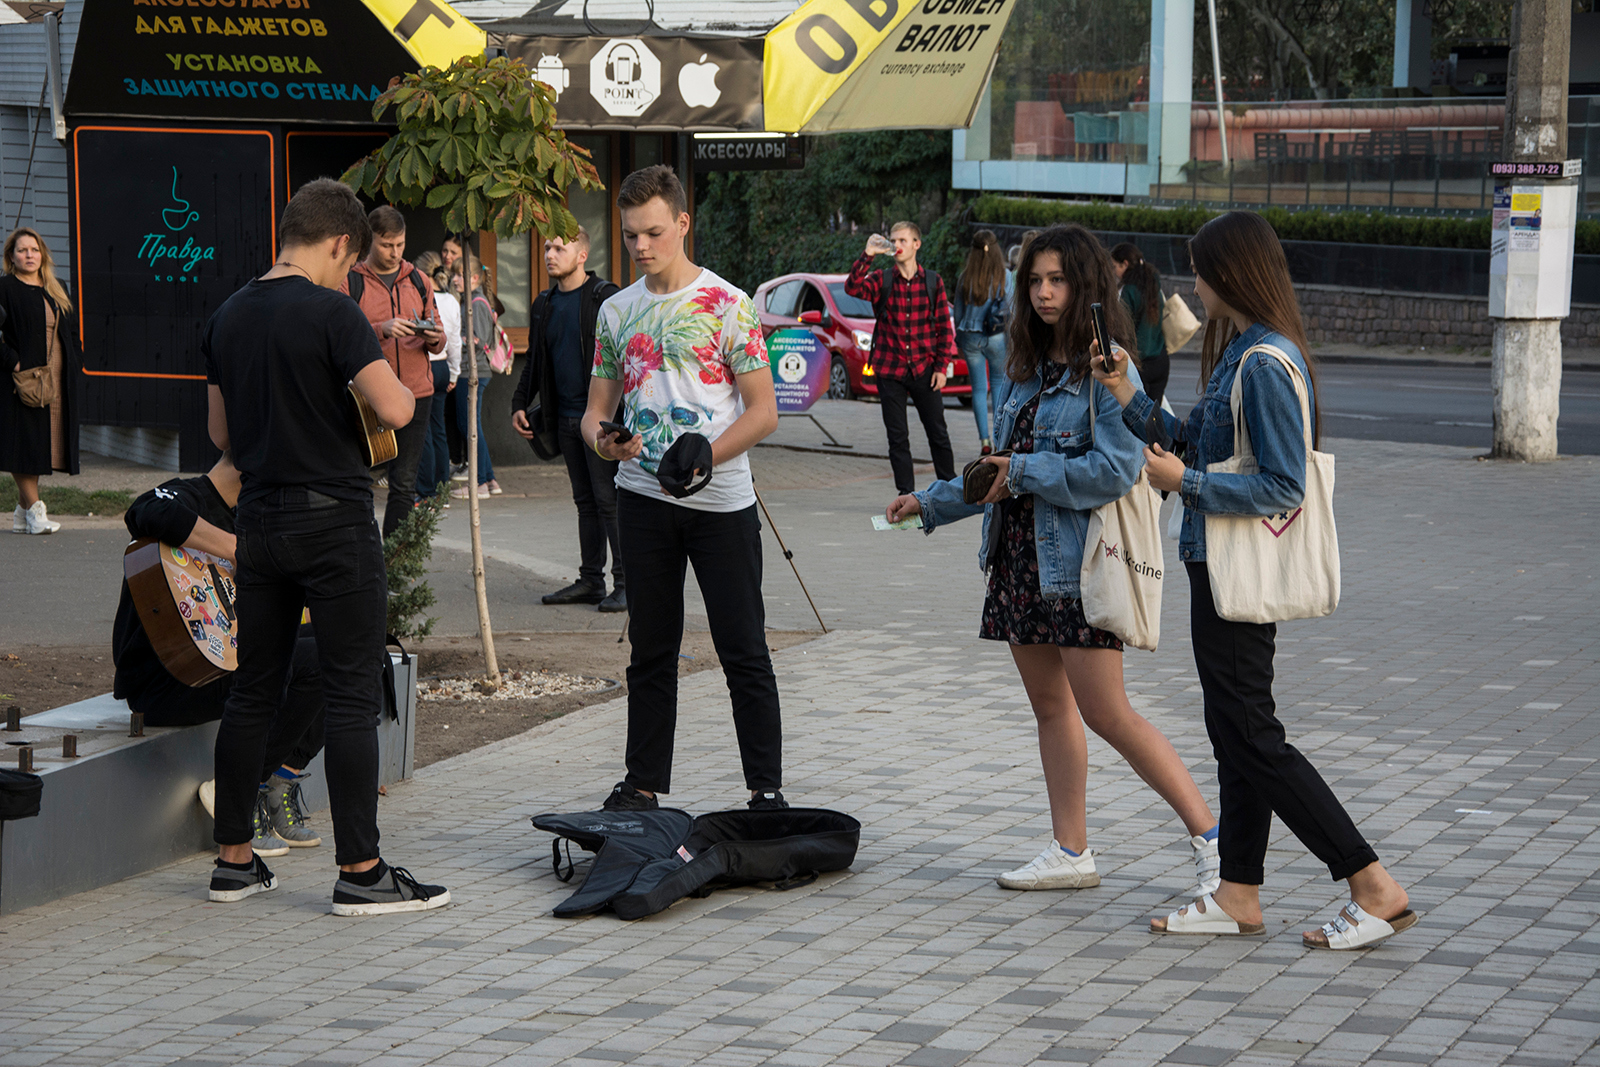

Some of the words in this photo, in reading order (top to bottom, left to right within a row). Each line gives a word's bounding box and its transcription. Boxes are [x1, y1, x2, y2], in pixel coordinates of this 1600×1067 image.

[135, 14, 187, 35] ДЛЯ
[191, 16, 328, 37] ГАДЖЕТОВ
[895, 24, 991, 52] ВАЛЮТ
[165, 53, 323, 74] УСТАНОВКА
[880, 63, 922, 77] currency
[923, 61, 966, 77] exchange
[123, 77, 280, 98] ЗАЩИТНОГО
[285, 82, 383, 101] СТЕКЛА
[604, 88, 643, 99] POINT
[1492, 163, 1516, 174] (093)
[1517, 164, 1559, 174] 388-77-22
[137, 232, 215, 272] Правда
